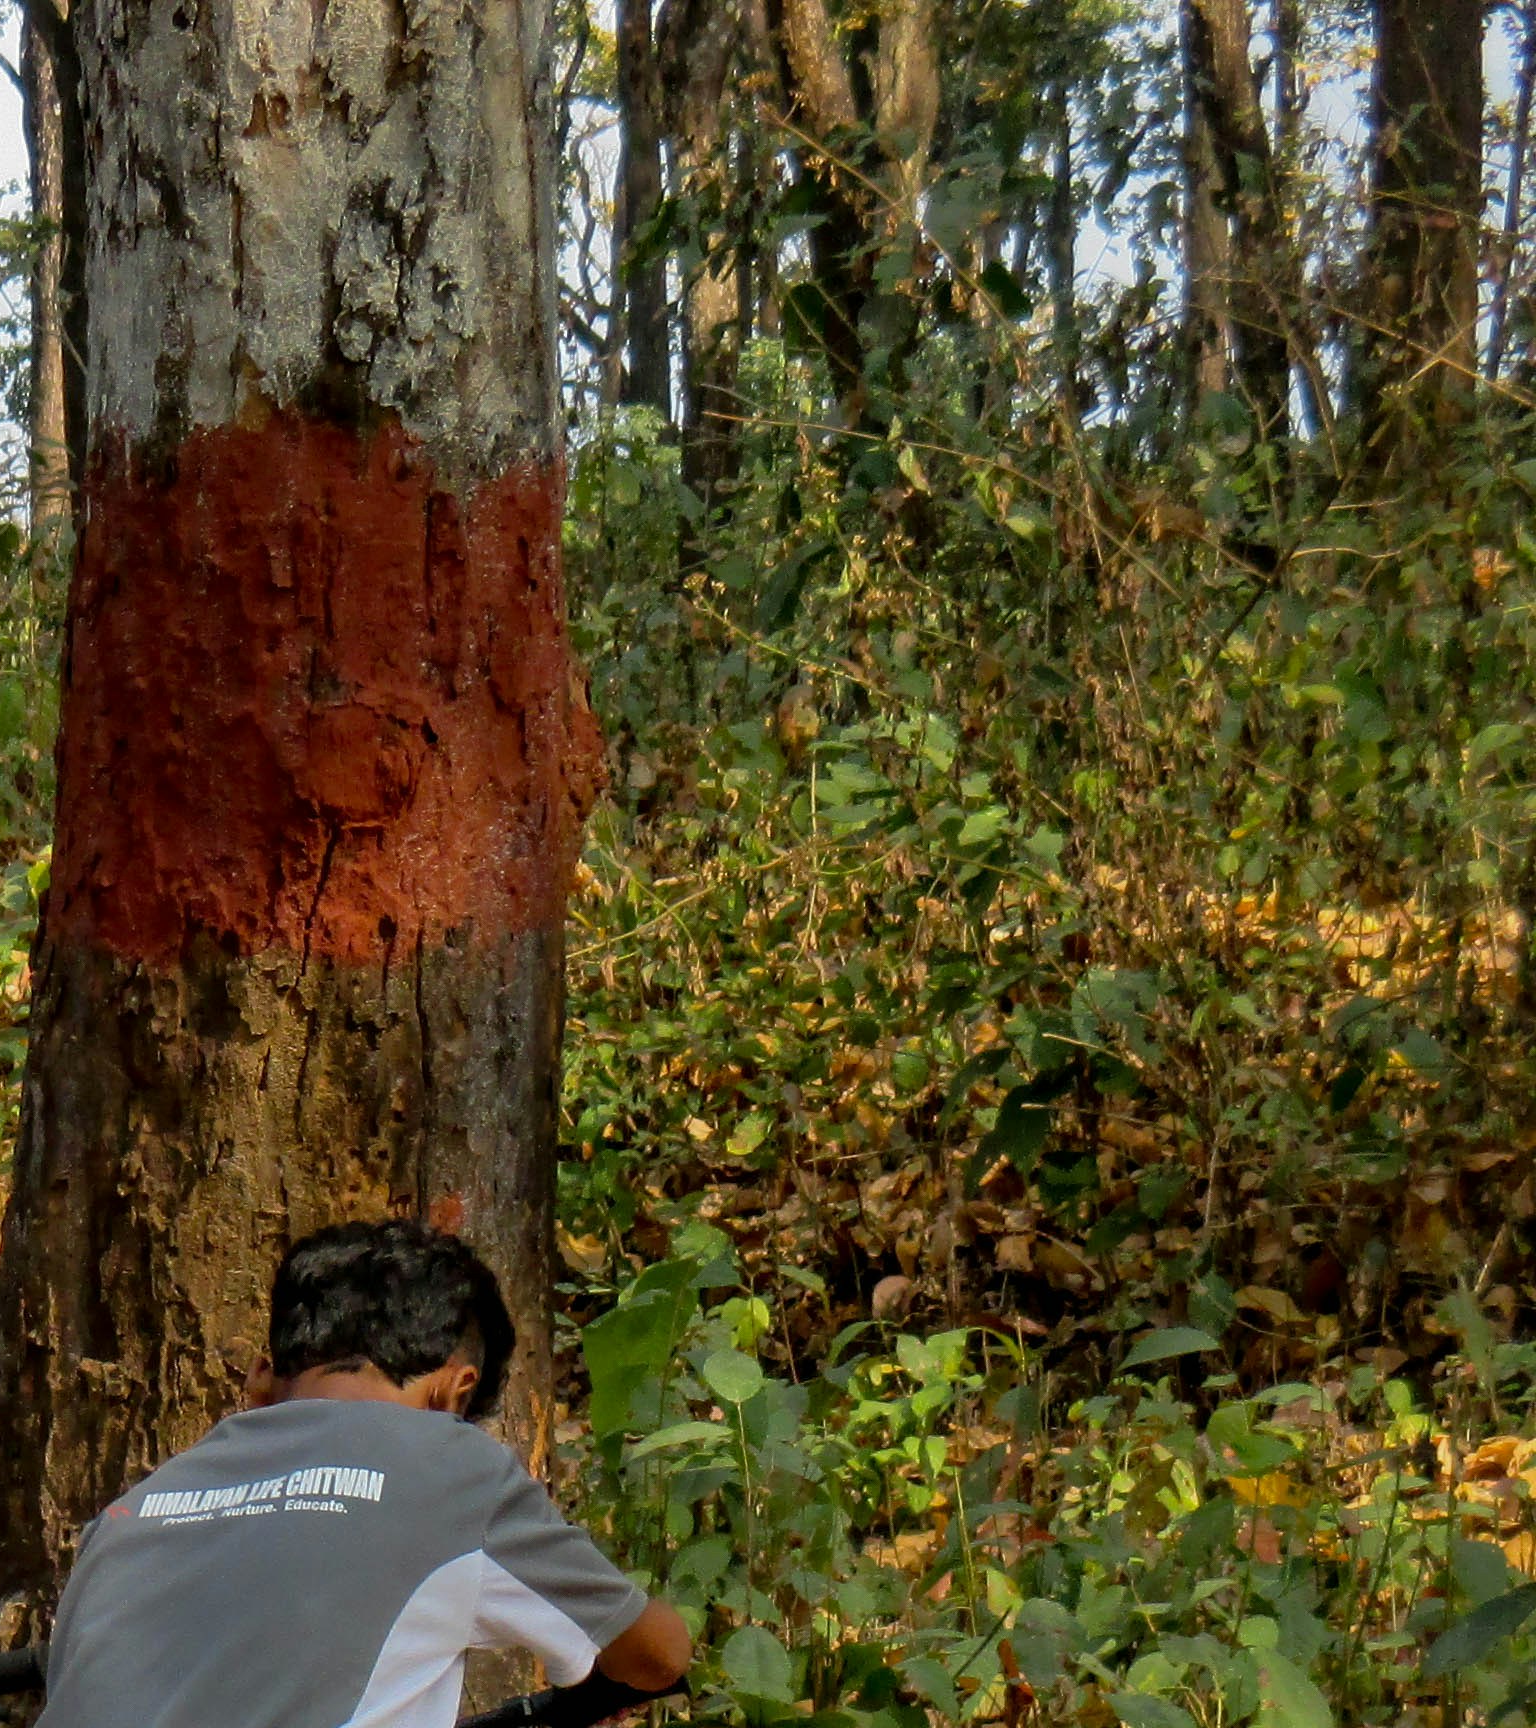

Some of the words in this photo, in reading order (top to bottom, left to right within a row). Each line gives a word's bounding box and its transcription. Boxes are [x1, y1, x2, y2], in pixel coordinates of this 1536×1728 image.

[138, 1484, 250, 1518] HIMALAYAN
[245, 1475, 287, 1502] LIFE
[285, 1467, 385, 1502] CHITWAN
[221, 1503, 277, 1517] Nurture.
[284, 1499, 348, 1514] Educate.
